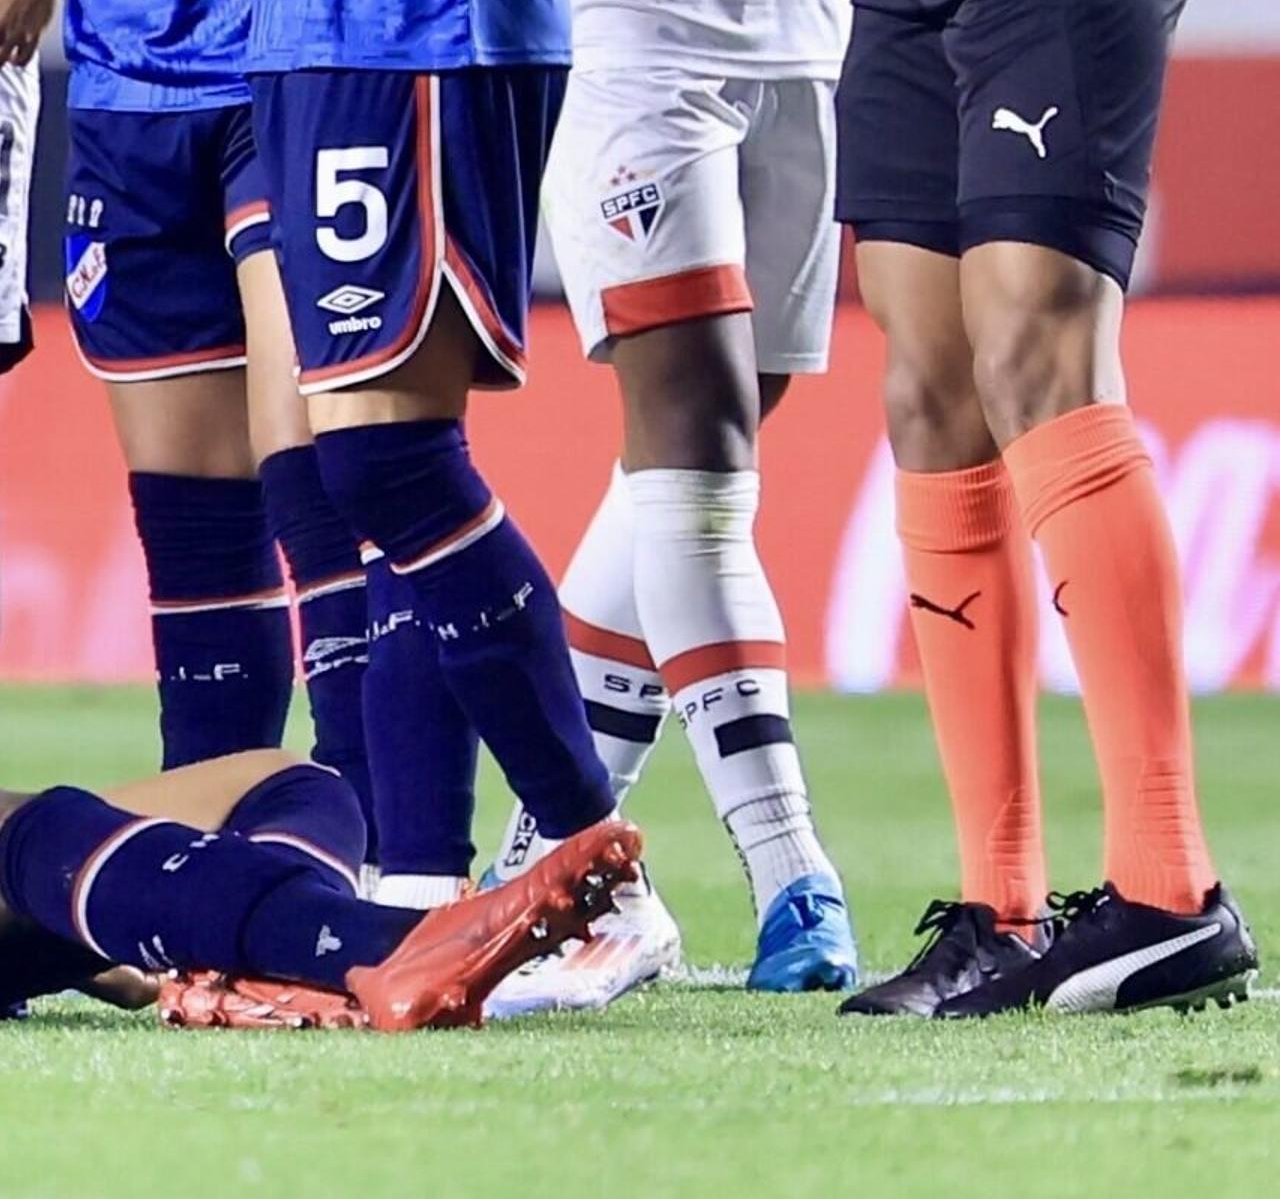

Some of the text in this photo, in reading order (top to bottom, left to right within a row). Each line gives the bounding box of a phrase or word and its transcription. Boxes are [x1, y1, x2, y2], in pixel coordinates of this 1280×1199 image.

[316, 146, 388, 262] 5
[603, 186, 657, 217] SPFC
[328, 315, 382, 336] umbro
